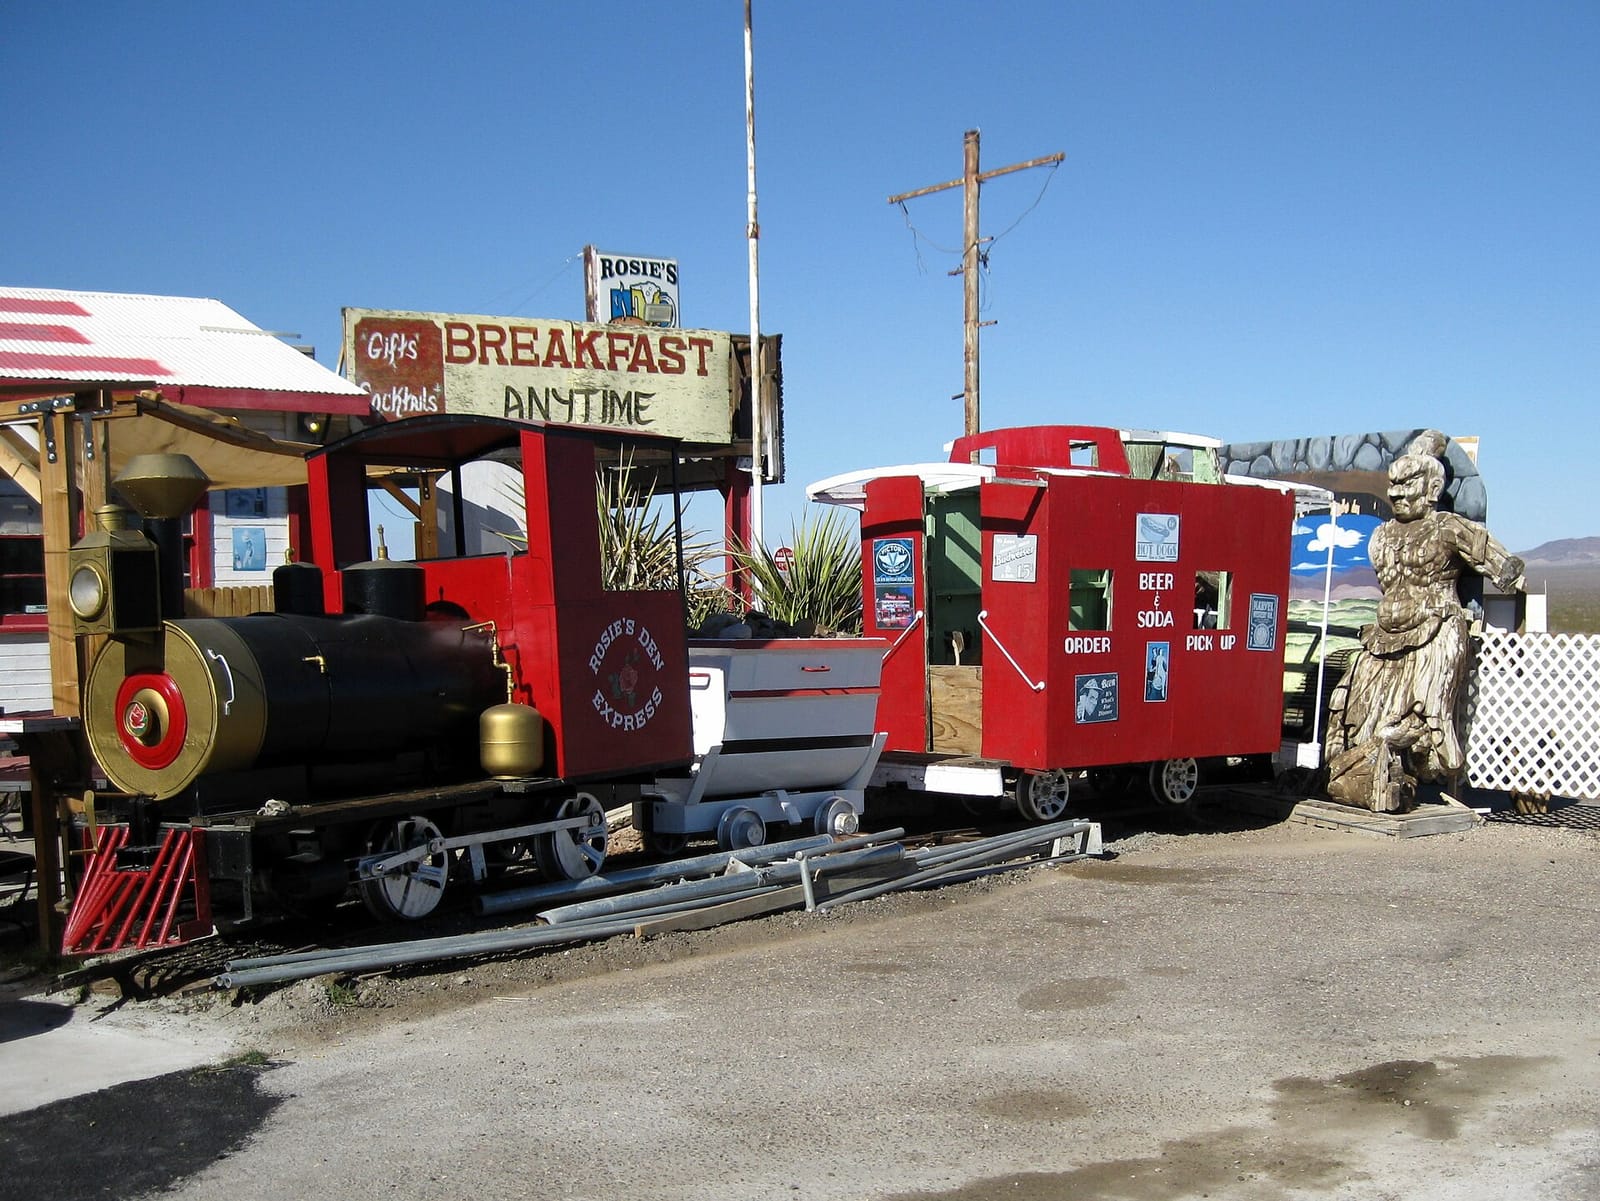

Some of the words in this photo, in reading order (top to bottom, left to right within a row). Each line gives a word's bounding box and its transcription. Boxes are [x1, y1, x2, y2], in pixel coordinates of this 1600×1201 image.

[600, 258, 677, 285] ROSIE'S
[367, 331, 418, 366] Gifts
[444, 321, 714, 377] BREAKFAST
[504, 385, 657, 425] ANYTIME
[1139, 573, 1174, 590] BEER
[1137, 610, 1174, 628] SODA
[588, 617, 636, 675] ROSIE'S
[638, 626, 665, 671] DEN
[1064, 637, 1111, 654] ORDER
[1186, 635, 1213, 651] PICK
[1220, 634, 1236, 650] UP
[592, 685, 663, 731] EXPRESS
